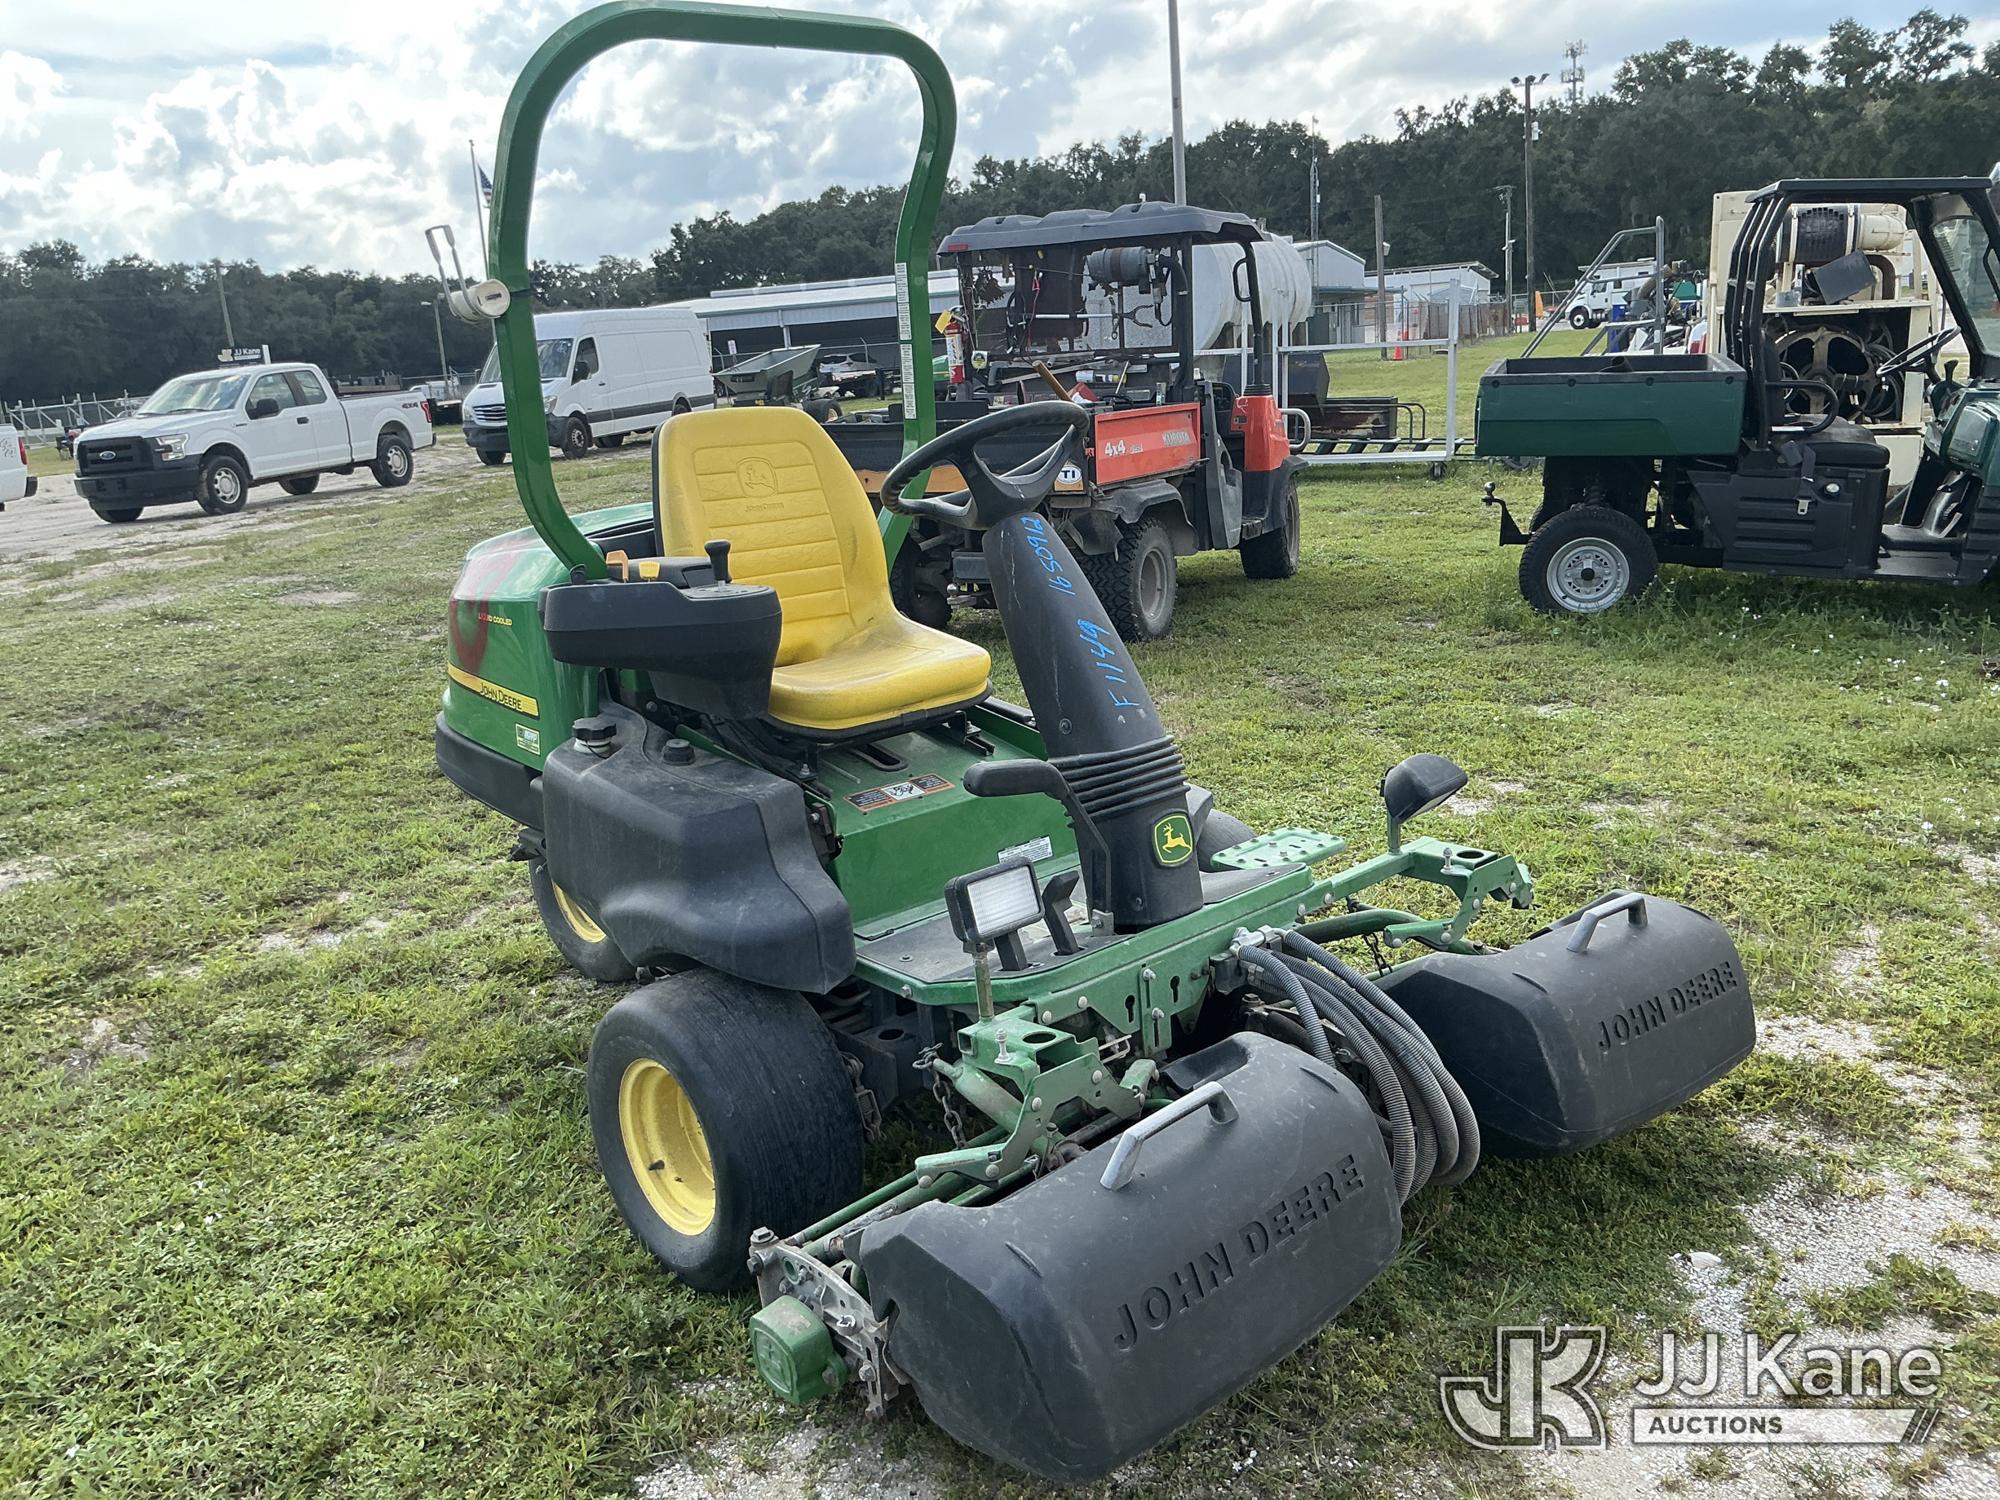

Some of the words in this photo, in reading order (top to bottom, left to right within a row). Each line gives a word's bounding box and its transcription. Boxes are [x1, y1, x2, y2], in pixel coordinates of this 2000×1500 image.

[1104, 439, 1126, 457] 4x4
[480, 681, 498, 701] JOHN
[497, 689, 522, 710] DEERE
[1598, 995, 1667, 1054] JOHN
[1667, 960, 1738, 1019] DEERE
[1113, 1241, 1234, 1352] JOHN
[1239, 1153, 1365, 1267] DEERE
